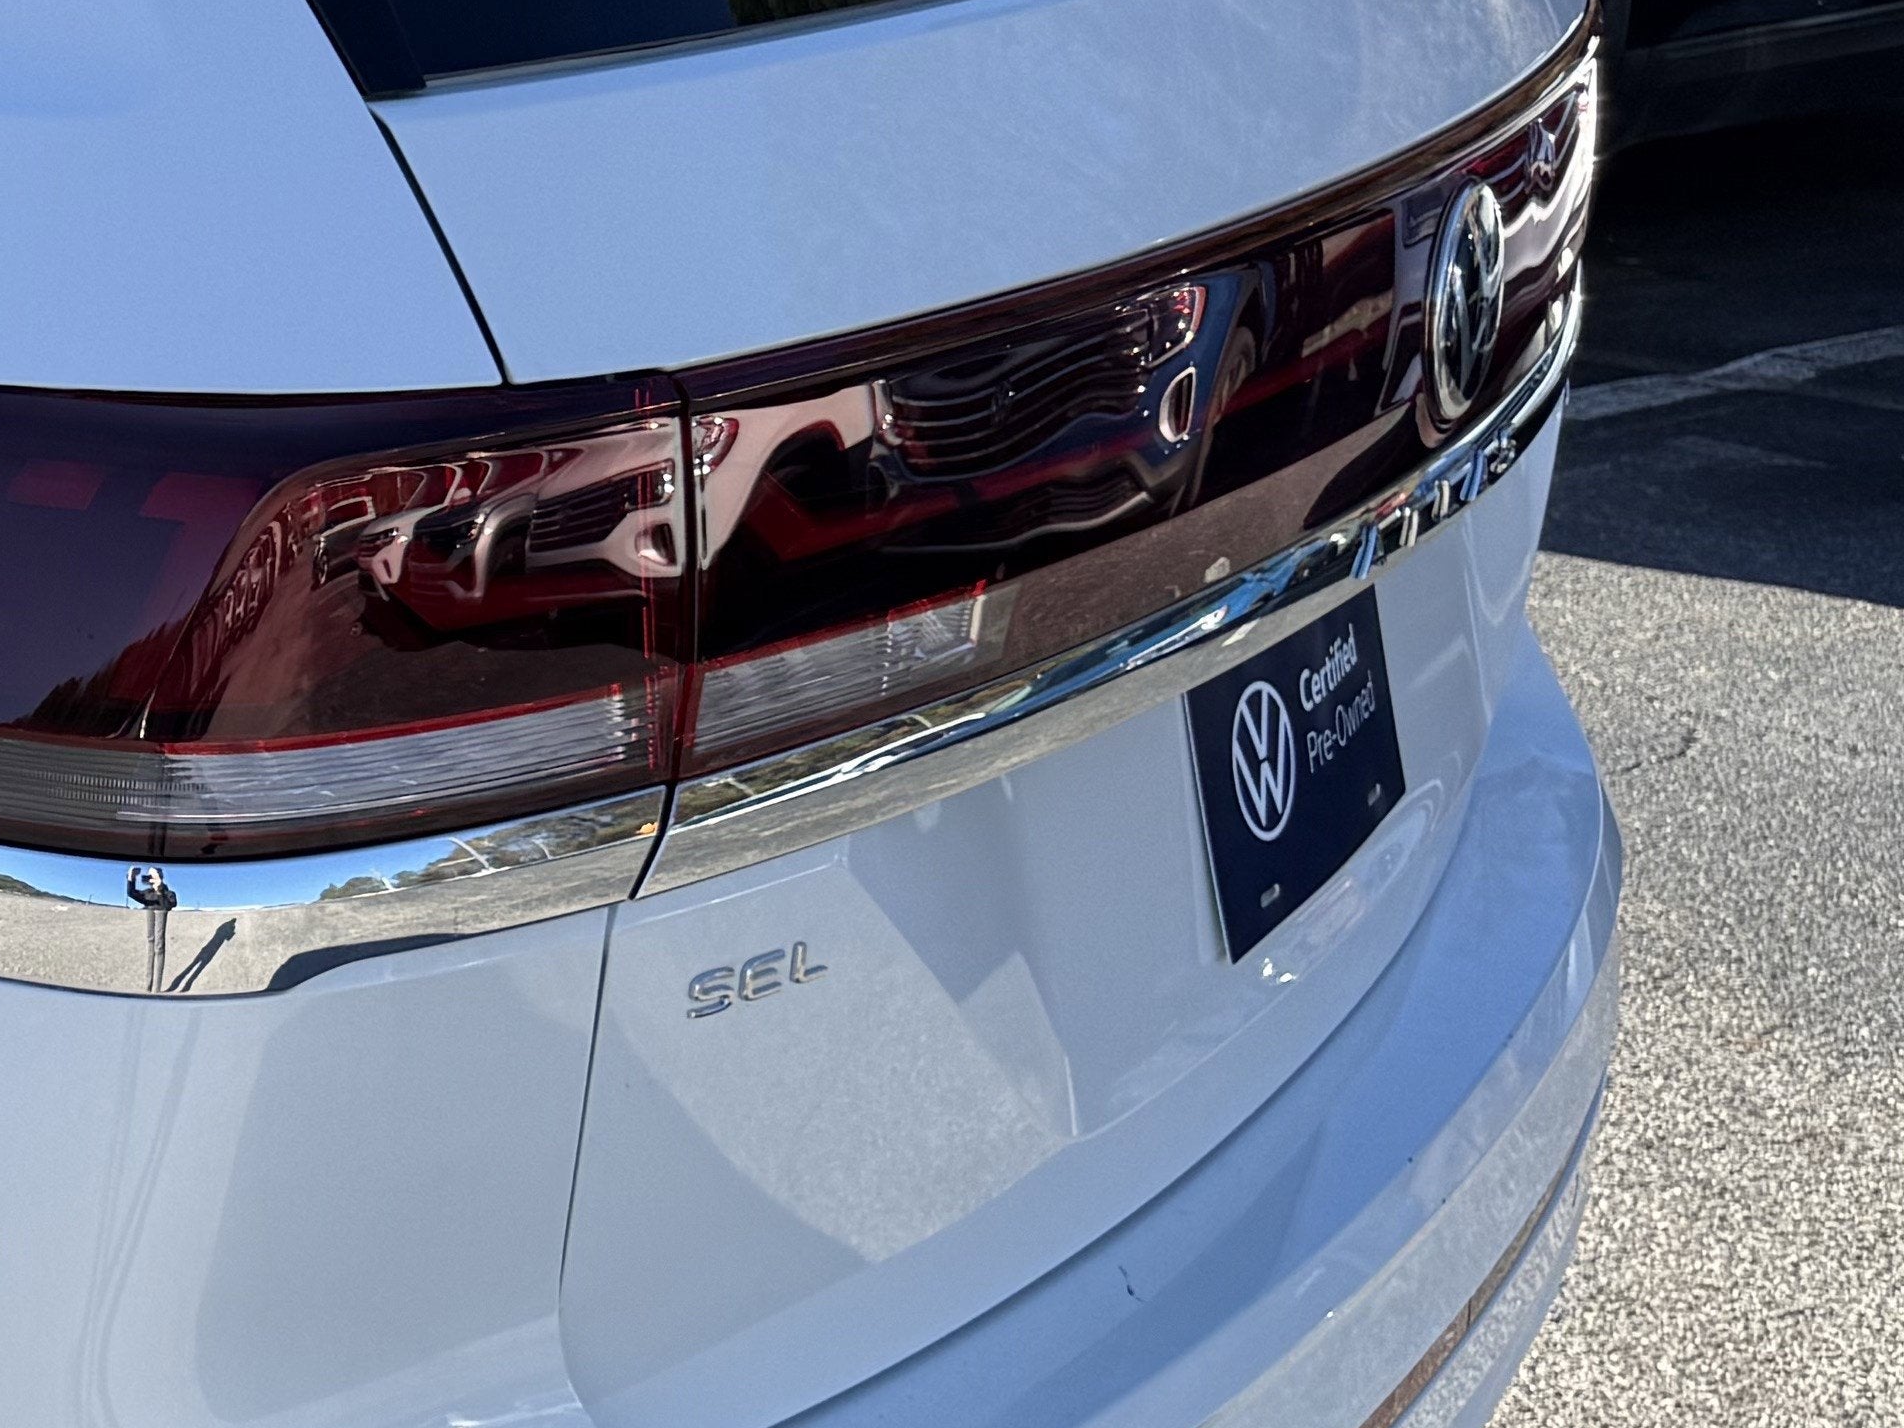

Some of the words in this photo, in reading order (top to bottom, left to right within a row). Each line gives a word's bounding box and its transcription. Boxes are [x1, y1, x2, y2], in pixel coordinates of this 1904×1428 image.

[1298, 622, 1359, 712] Certified
[1305, 670, 1377, 774] Pre-Owned
[686, 940, 829, 1019] SEL
